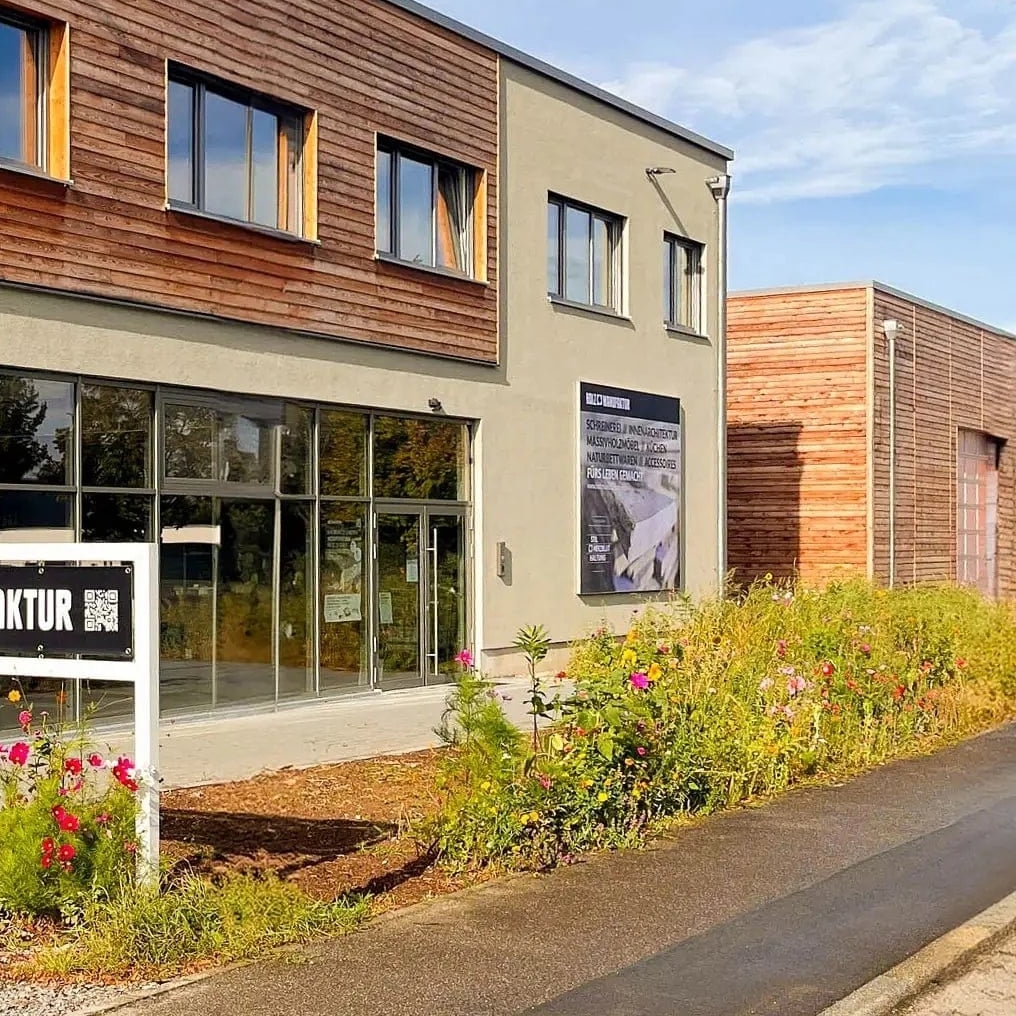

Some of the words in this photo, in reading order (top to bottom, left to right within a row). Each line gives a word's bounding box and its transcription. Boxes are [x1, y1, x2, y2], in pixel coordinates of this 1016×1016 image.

[586, 419, 622, 434] SCHREINEREI
[629, 424, 678, 440] INNENARCHITEKTUR
[586, 435, 639, 452] MASSIVHOLZMÖBEL
[646, 440, 667, 453] KÜCHEN
[586, 452, 638, 466] NATURBETTWAREN
[645, 457, 677, 469] ACCESSOIRES
[586, 465, 602, 479] FÜRS
[602, 468, 619, 480] LEBEN
[619, 469, 644, 482] GEMACHT
